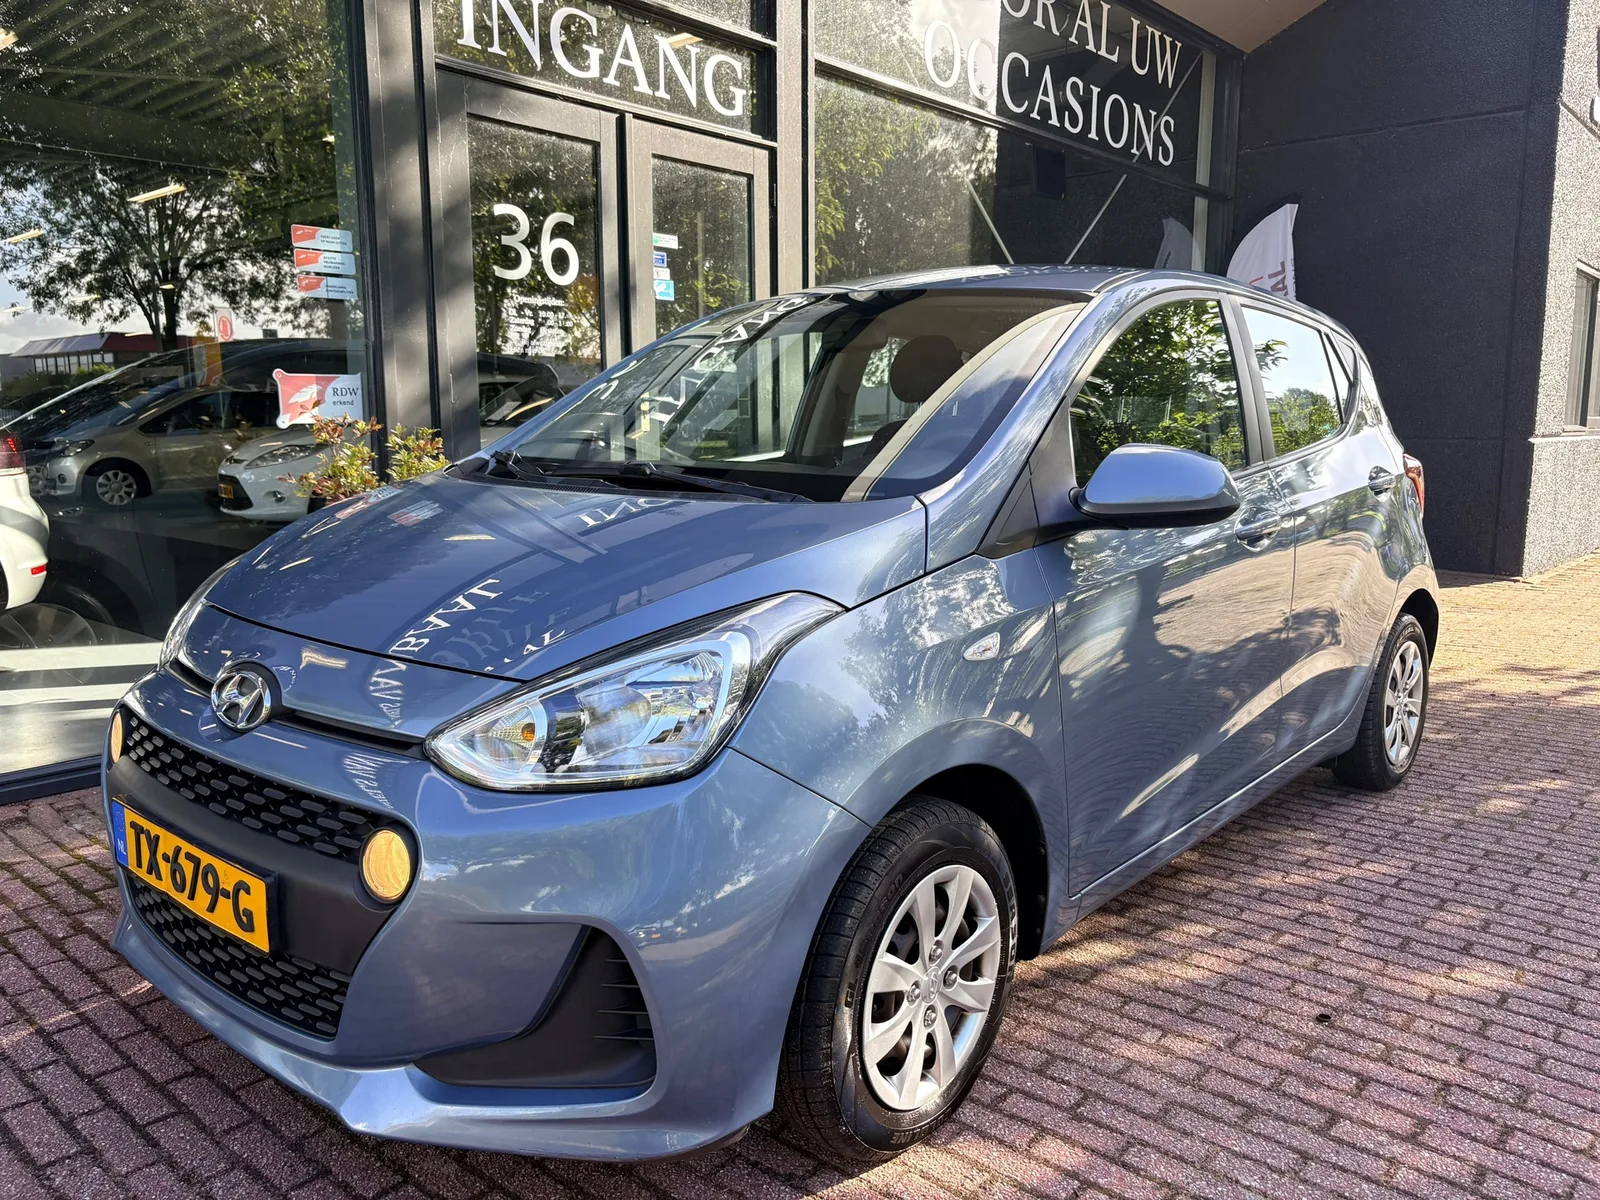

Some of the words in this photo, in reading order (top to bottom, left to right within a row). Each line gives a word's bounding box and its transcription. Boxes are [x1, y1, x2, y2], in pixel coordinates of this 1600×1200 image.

[457, 0, 747, 117] INGANG
[1068, 0, 1120, 63] AL
[1131, 16, 1183, 89] UW
[924, 20, 1175, 167] OCCASIONS
[492, 203, 580, 286] 36
[331, 386, 360, 397] RDW
[117, 837, 127, 856] NL
[129, 820, 255, 933] TX-679-G
